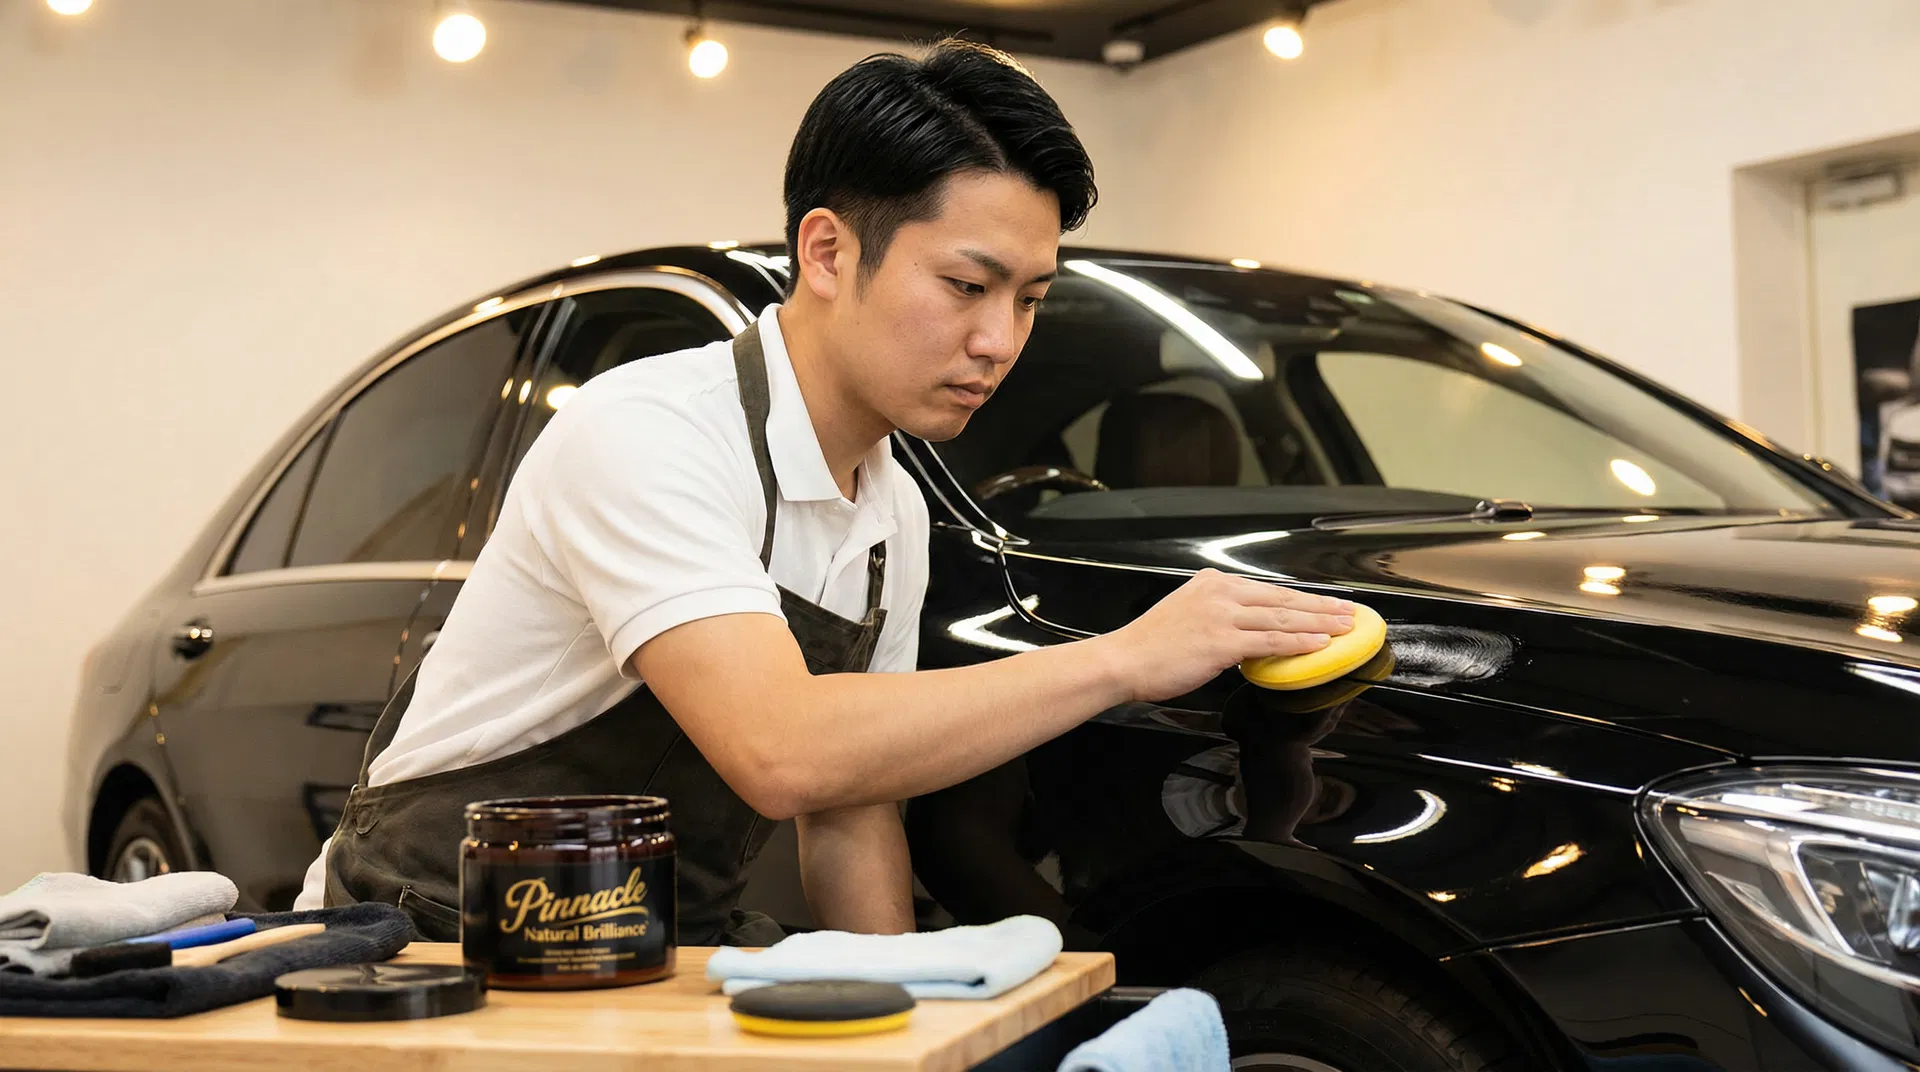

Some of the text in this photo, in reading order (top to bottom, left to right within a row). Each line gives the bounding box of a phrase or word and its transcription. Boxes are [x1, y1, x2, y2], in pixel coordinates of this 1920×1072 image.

[500, 866, 648, 933] Pinnacle
[524, 922, 647, 942] Natural Brilliance
